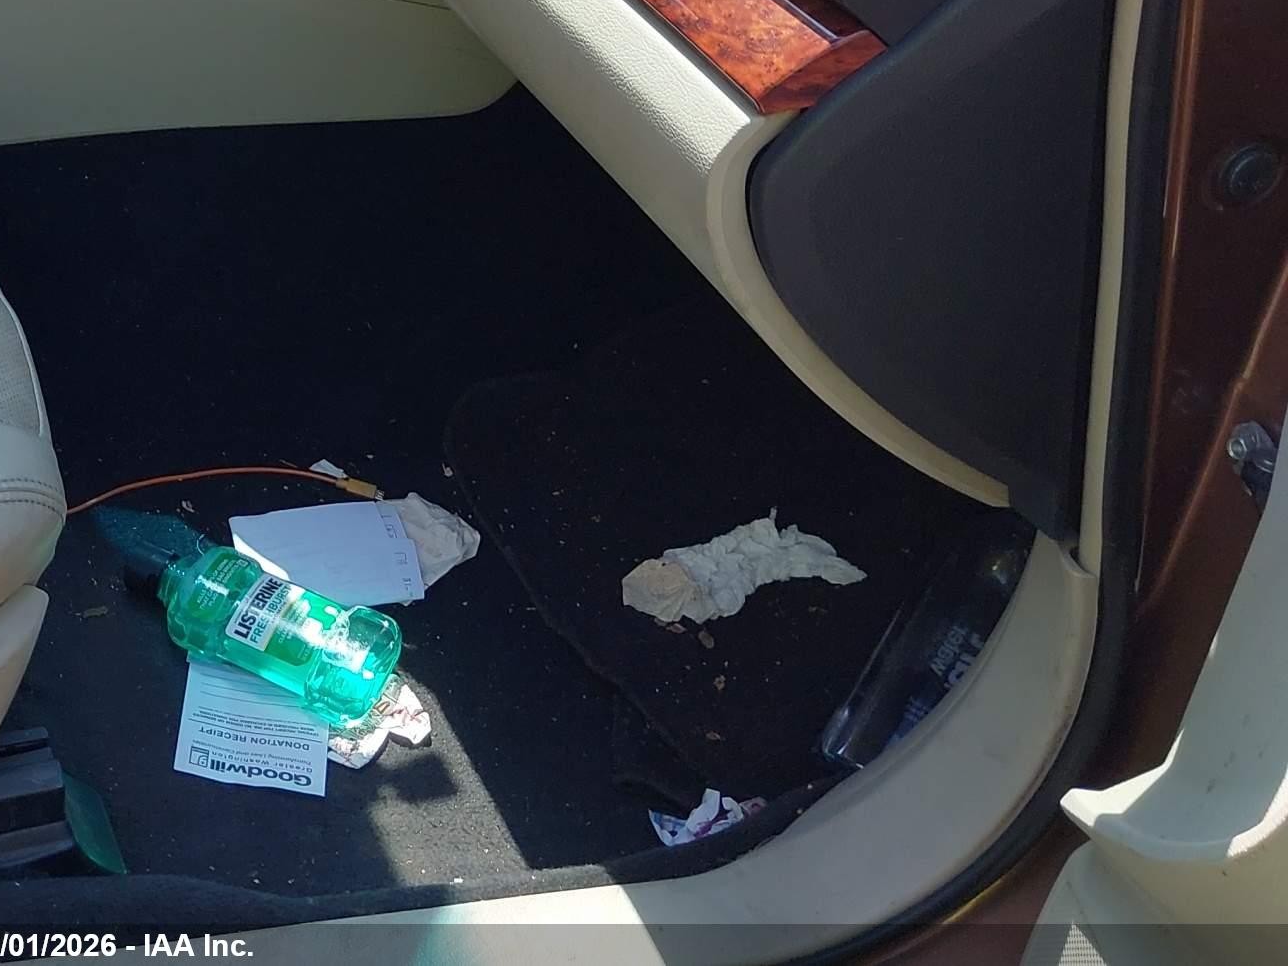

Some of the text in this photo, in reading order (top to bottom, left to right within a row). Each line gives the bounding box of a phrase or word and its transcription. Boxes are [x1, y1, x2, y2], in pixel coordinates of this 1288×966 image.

[234, 578, 283, 639] LISTERINE
[199, 726, 310, 751] DONATION RECEIPT
[210, 759, 312, 787] Goodwill
[211, 751, 312, 773] Greater Washington
